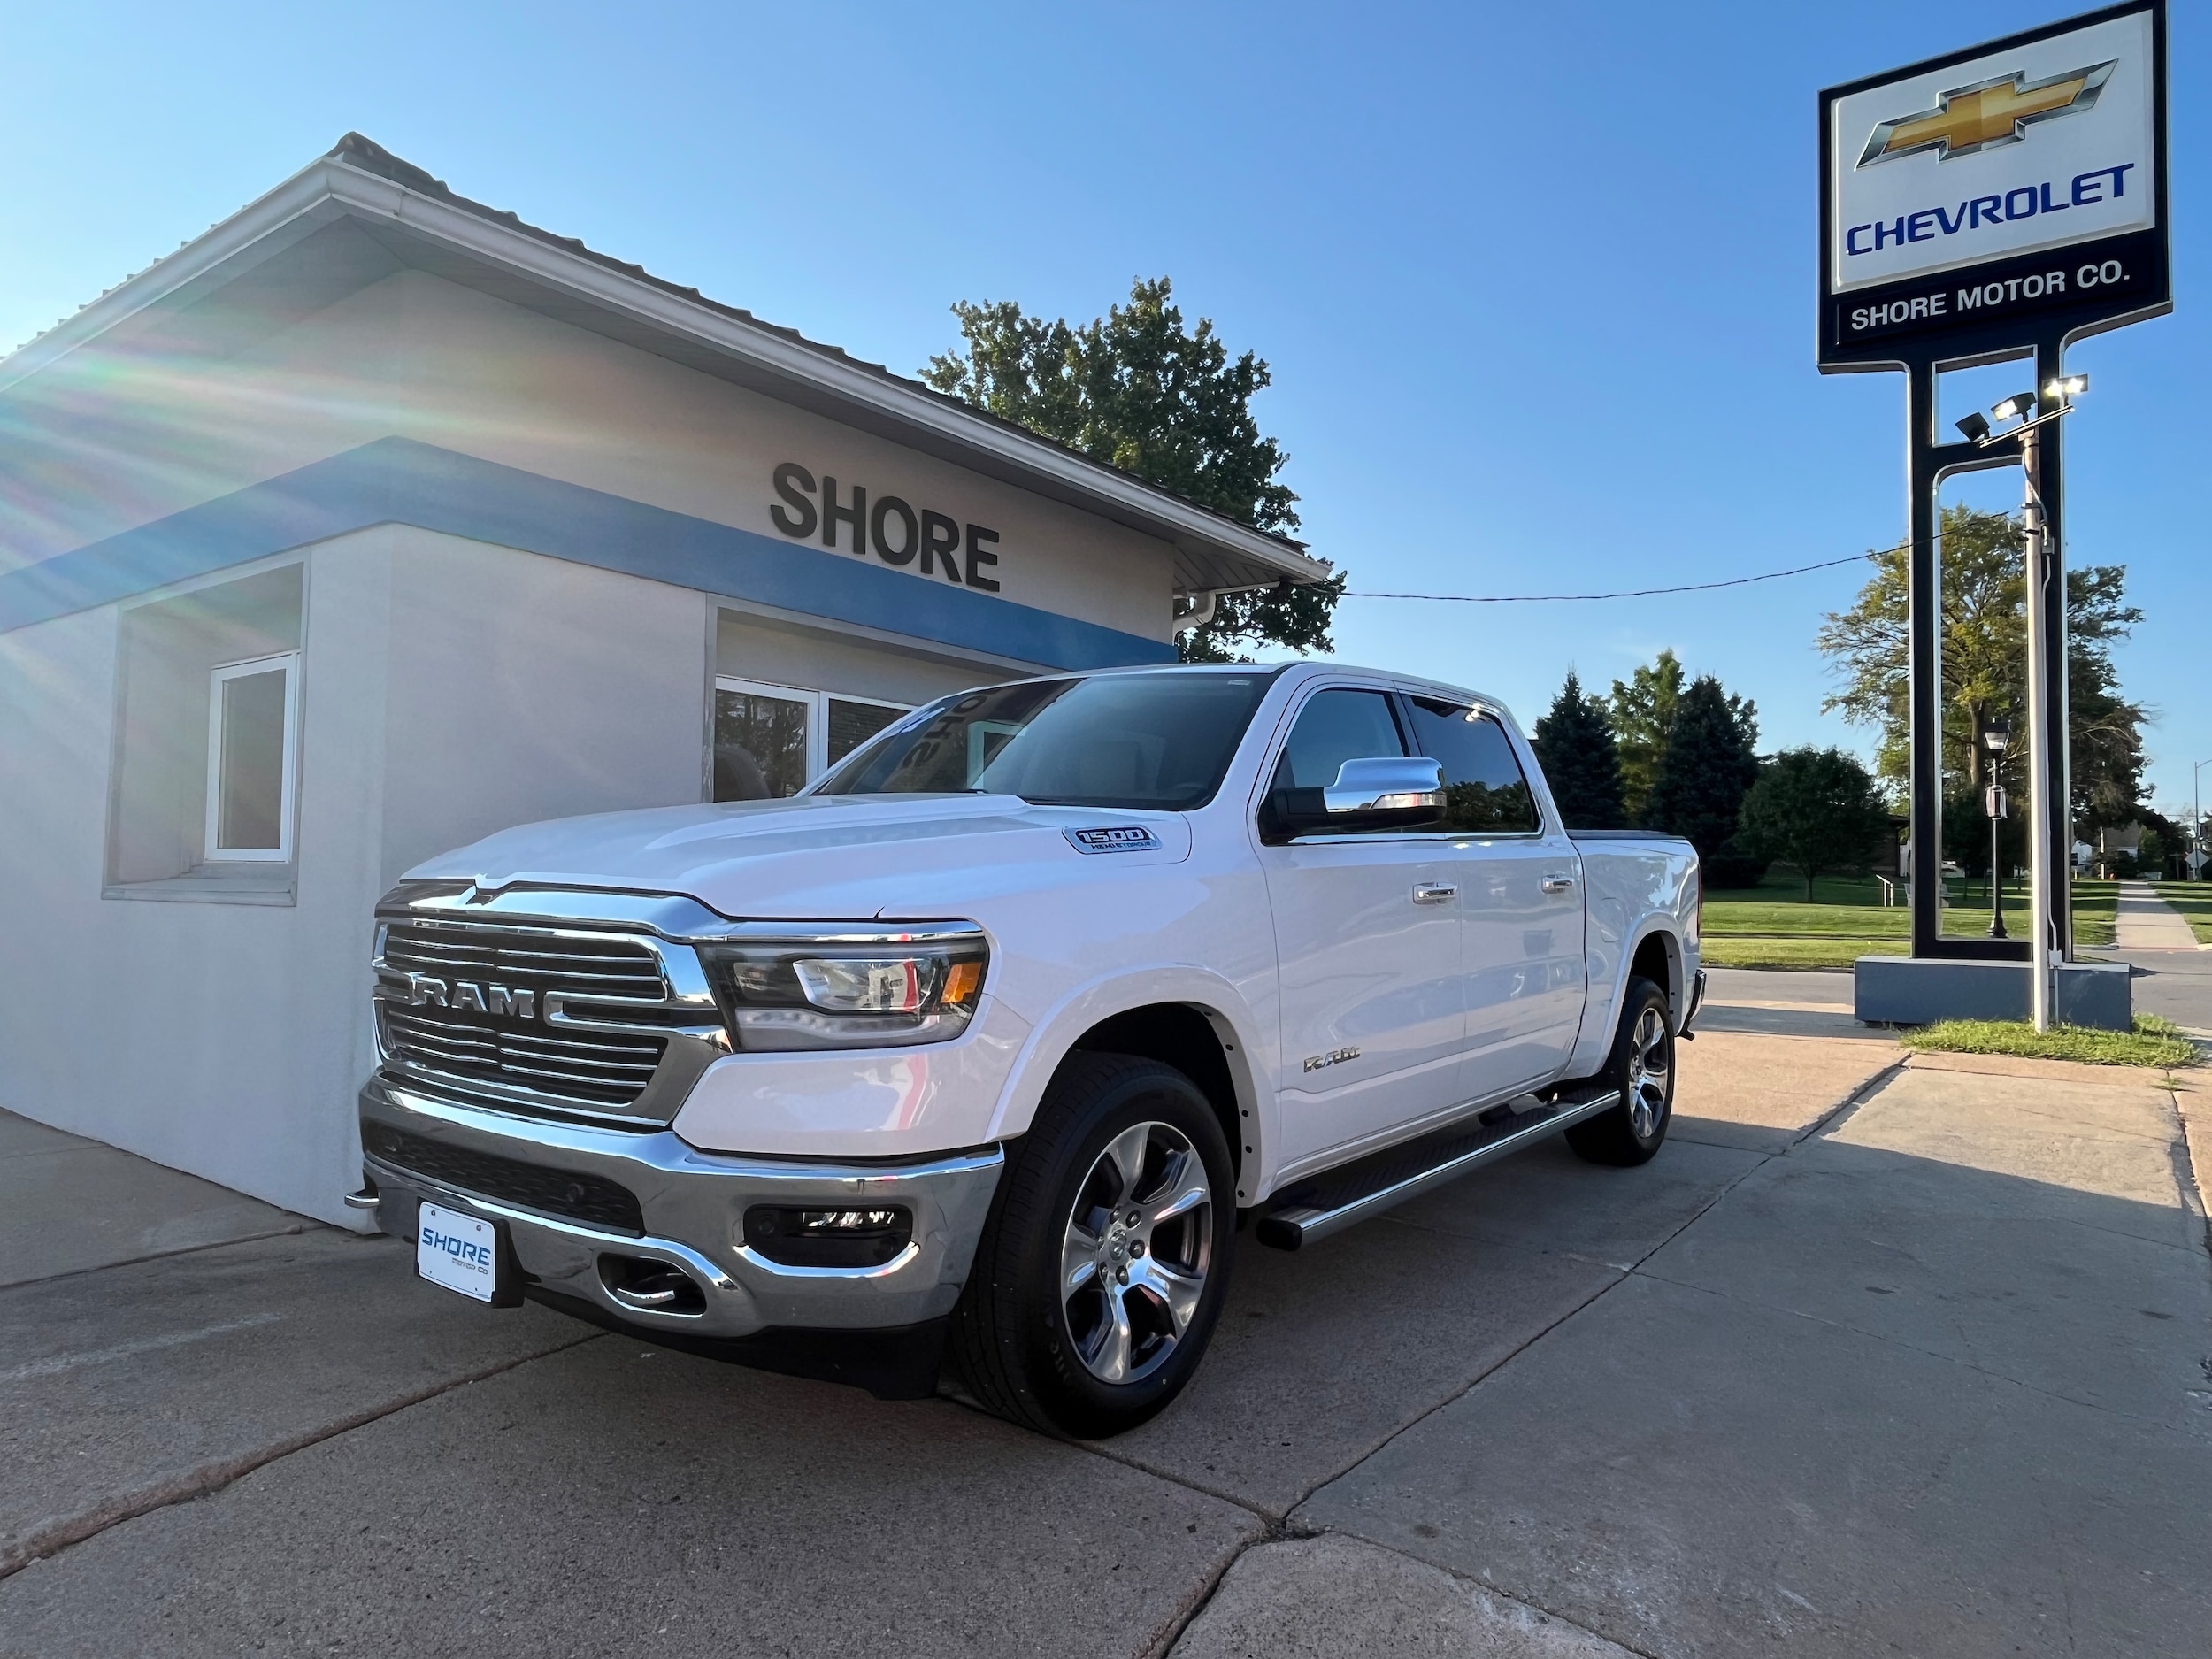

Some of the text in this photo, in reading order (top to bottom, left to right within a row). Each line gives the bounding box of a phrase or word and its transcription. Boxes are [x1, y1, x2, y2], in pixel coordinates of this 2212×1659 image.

[1847, 163, 2134, 256] CHEVROLET
[1851, 259, 2131, 330] SHORE MOTOR CO.
[770, 462, 1000, 592] SHORE
[1078, 829, 1145, 843] 1500
[412, 975, 535, 1018] RAM
[1303, 1047, 1361, 1073] RAM
[422, 1227, 491, 1266] SHORE
